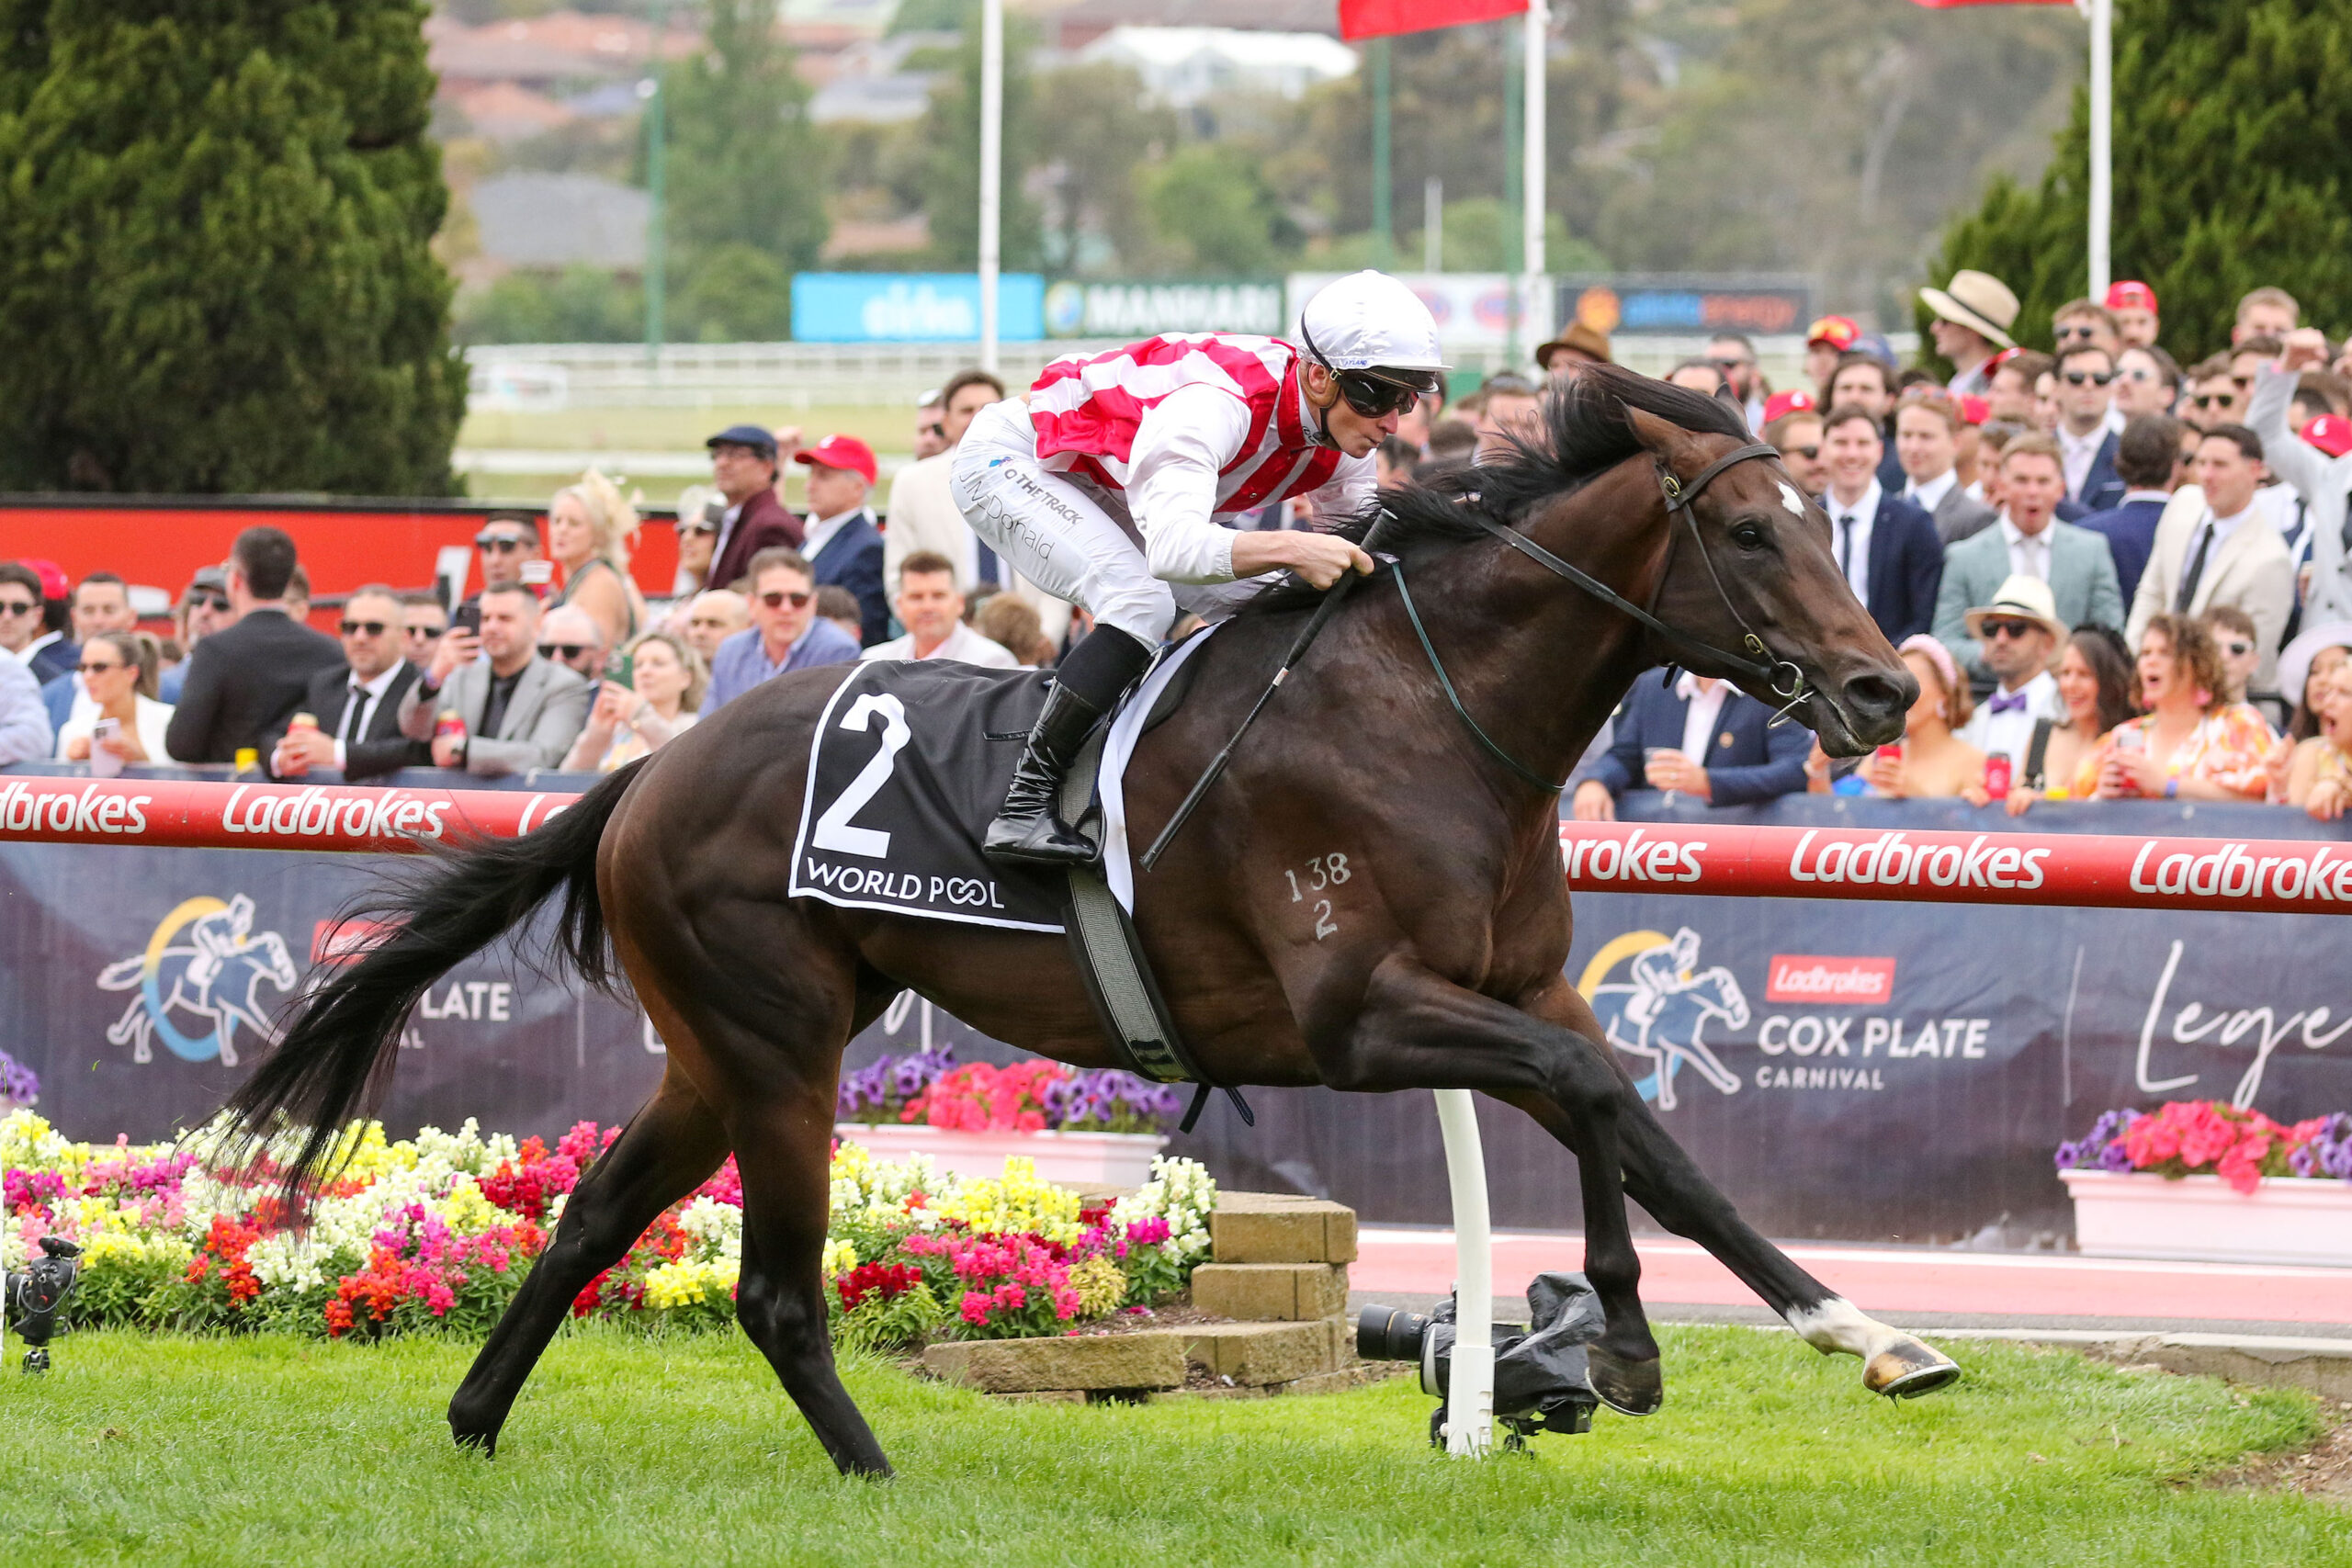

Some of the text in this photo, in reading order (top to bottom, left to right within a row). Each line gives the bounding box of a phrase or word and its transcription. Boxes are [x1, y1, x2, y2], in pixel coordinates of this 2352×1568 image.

[811, 693, 912, 860] 2
[221, 784, 452, 840] Ladbrokes
[807, 856, 1005, 909] WORLD POOL
[1284, 852, 1351, 904] 138
[1789, 829, 2052, 890] Ladbrokes
[1314, 899, 1338, 941] 2
[421, 981, 512, 1021] LATE
[1774, 964, 1886, 995] Ladbrokes
[1758, 1014, 1991, 1058] COX PLATE
[1755, 1065, 1885, 1091] CARNIVAL
